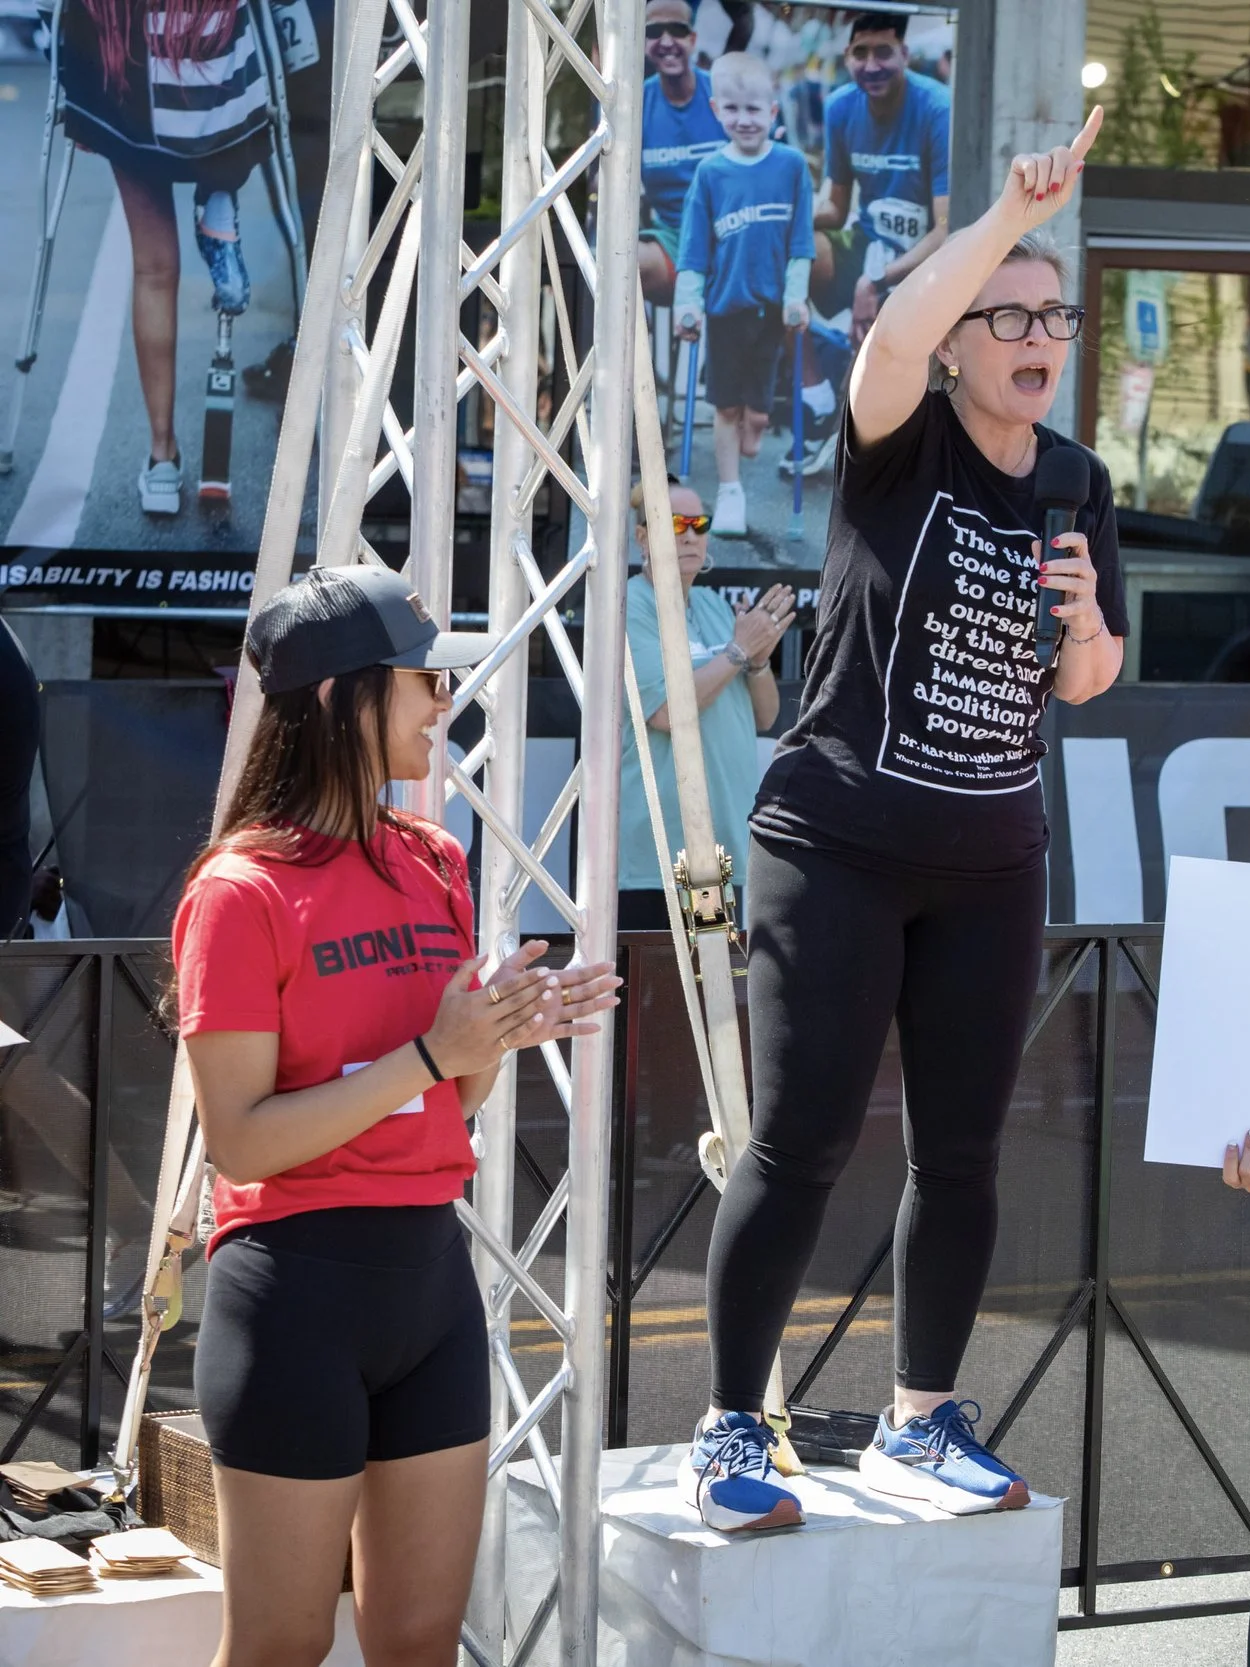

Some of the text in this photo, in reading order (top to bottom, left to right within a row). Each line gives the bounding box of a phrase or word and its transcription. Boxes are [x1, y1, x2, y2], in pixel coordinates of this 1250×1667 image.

[880, 212, 919, 237] 588
[948, 551, 1011, 584] come
[1002, 547, 1040, 570] tim
[0, 565, 257, 592] ISABILITY IS FASHIO
[954, 574, 1037, 618] to civi
[923, 612, 960, 640] by
[965, 628, 1006, 655] the
[949, 604, 1037, 643] oursel
[929, 640, 1046, 685] direct and
[913, 682, 1026, 727] abolition
[898, 733, 921, 750] Dr.
[921, 742, 967, 763] Martin
[968, 752, 1005, 764] Luther
[1005, 750, 1023, 762] King
[921, 762, 933, 771] do
[955, 770, 976, 779] from
